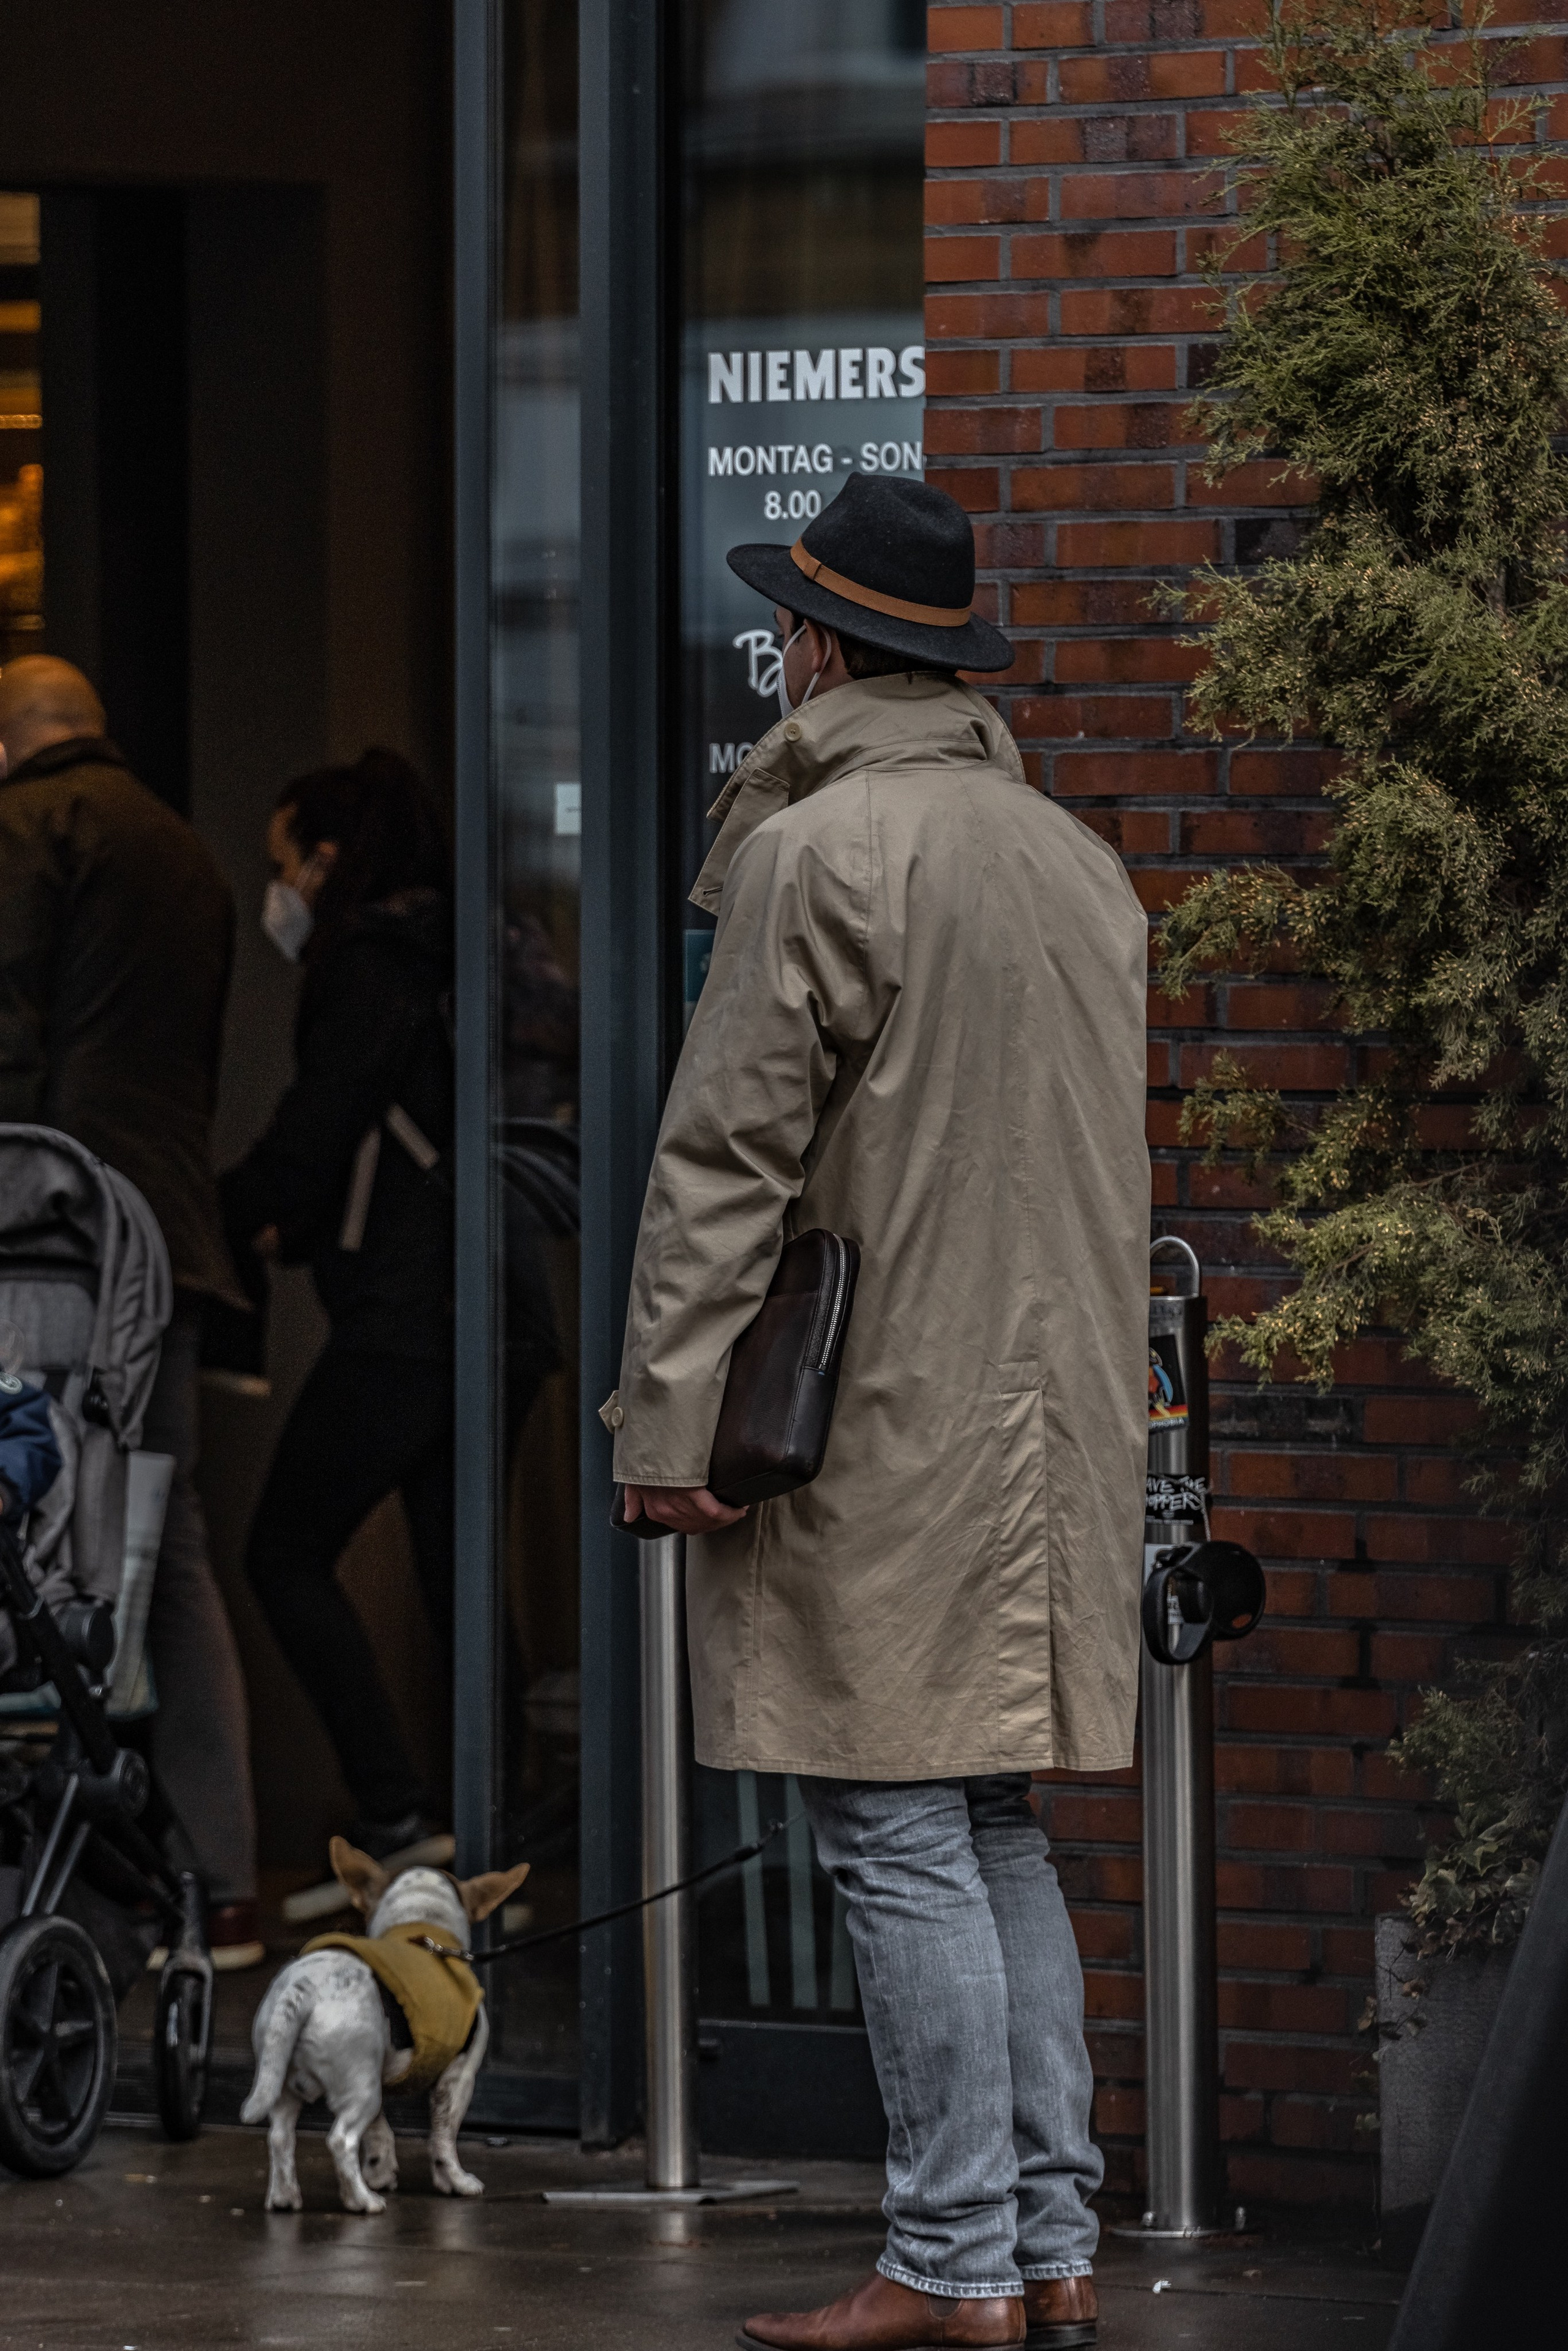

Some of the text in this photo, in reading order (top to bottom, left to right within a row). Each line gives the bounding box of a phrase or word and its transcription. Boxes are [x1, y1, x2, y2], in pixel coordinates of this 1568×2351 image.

[708, 443, 833, 477] MONTAG
[860, 441, 922, 472] SON
[764, 489, 822, 521] 8.00
